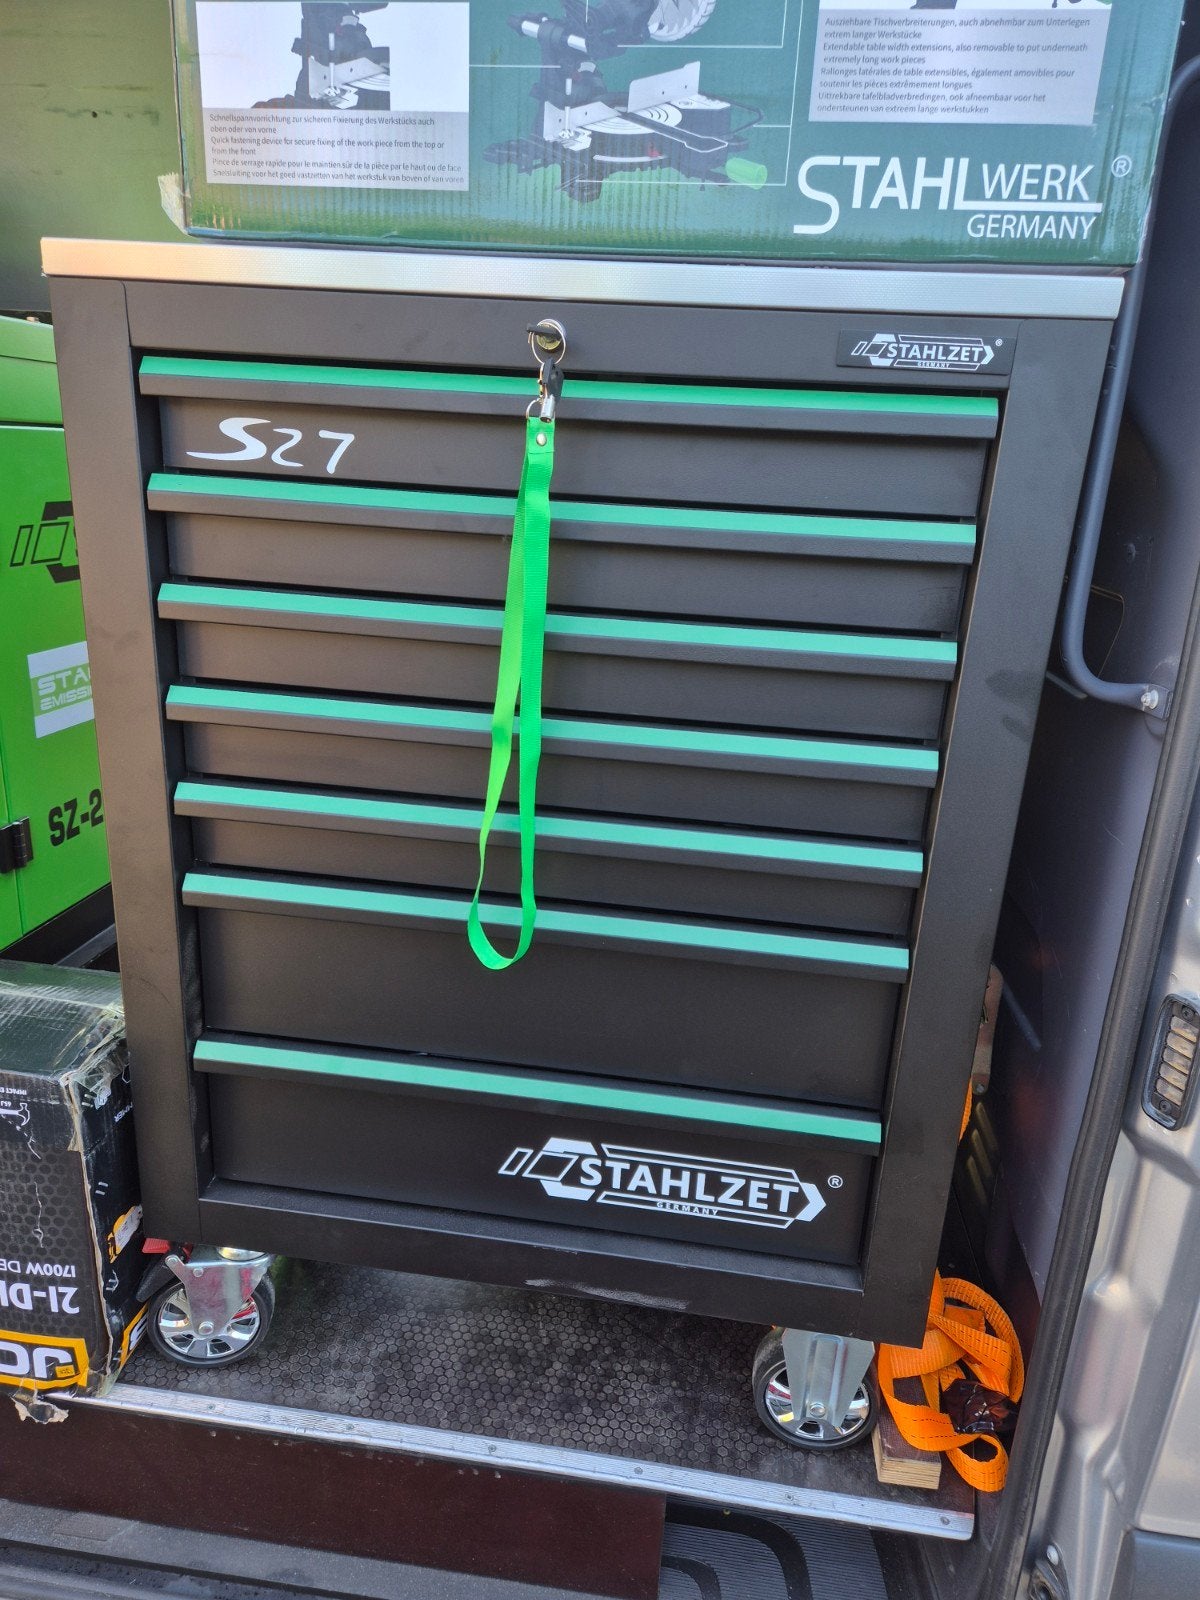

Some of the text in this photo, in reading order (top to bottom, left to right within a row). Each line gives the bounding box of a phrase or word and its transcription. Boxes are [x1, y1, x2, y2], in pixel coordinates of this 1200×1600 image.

[825, 18, 872, 26] Ausziehbare
[874, 18, 957, 28] Tischverbreiterungen,
[959, 18, 978, 26] auch
[980, 18, 1026, 26] abnehmbar
[1046, 18, 1090, 28] Unterlegen
[852, 30, 876, 40] langer
[878, 30, 922, 39] Werkstücke
[824, 43, 864, 51] Extendable
[867, 43, 886, 51] table
[888, 43, 909, 51] width
[911, 43, 954, 53] extensions,
[956, 43, 972, 52] also
[973, 43, 1014, 52] removable
[1026, 44, 1040, 54] put
[1042, 43, 1088, 52] underneath
[824, 55, 860, 65] extremely
[862, 56, 880, 65] long
[901, 56, 926, 65] pieces
[821, 68, 857, 78] Rallonges
[859, 67, 890, 76] latérales
[904, 68, 923, 76] table
[924, 68, 970, 78] extensibles,
[972, 68, 1012, 78] également
[1014, 68, 1054, 77] amovibles
[1056, 70, 1074, 78] pour
[864, 80, 888, 90] pièces
[942, 81, 972, 90] longues
[304, 116, 332, 124] sicheren
[333, 117, 364, 126] Fixierung
[230, 138, 260, 146] fastening
[317, 138, 335, 148] fixing
[375, 140, 392, 148] piece
[424, 141, 434, 150] top
[967, 214, 1096, 240] GERMANY
[886, 342, 984, 362] STAHLZET
[37, 666, 90, 696] STA
[579, 1158, 800, 1214] STAHLZET
[656, 1201, 719, 1216] GERMANY
[26, 1262, 76, 1278] 1700W
